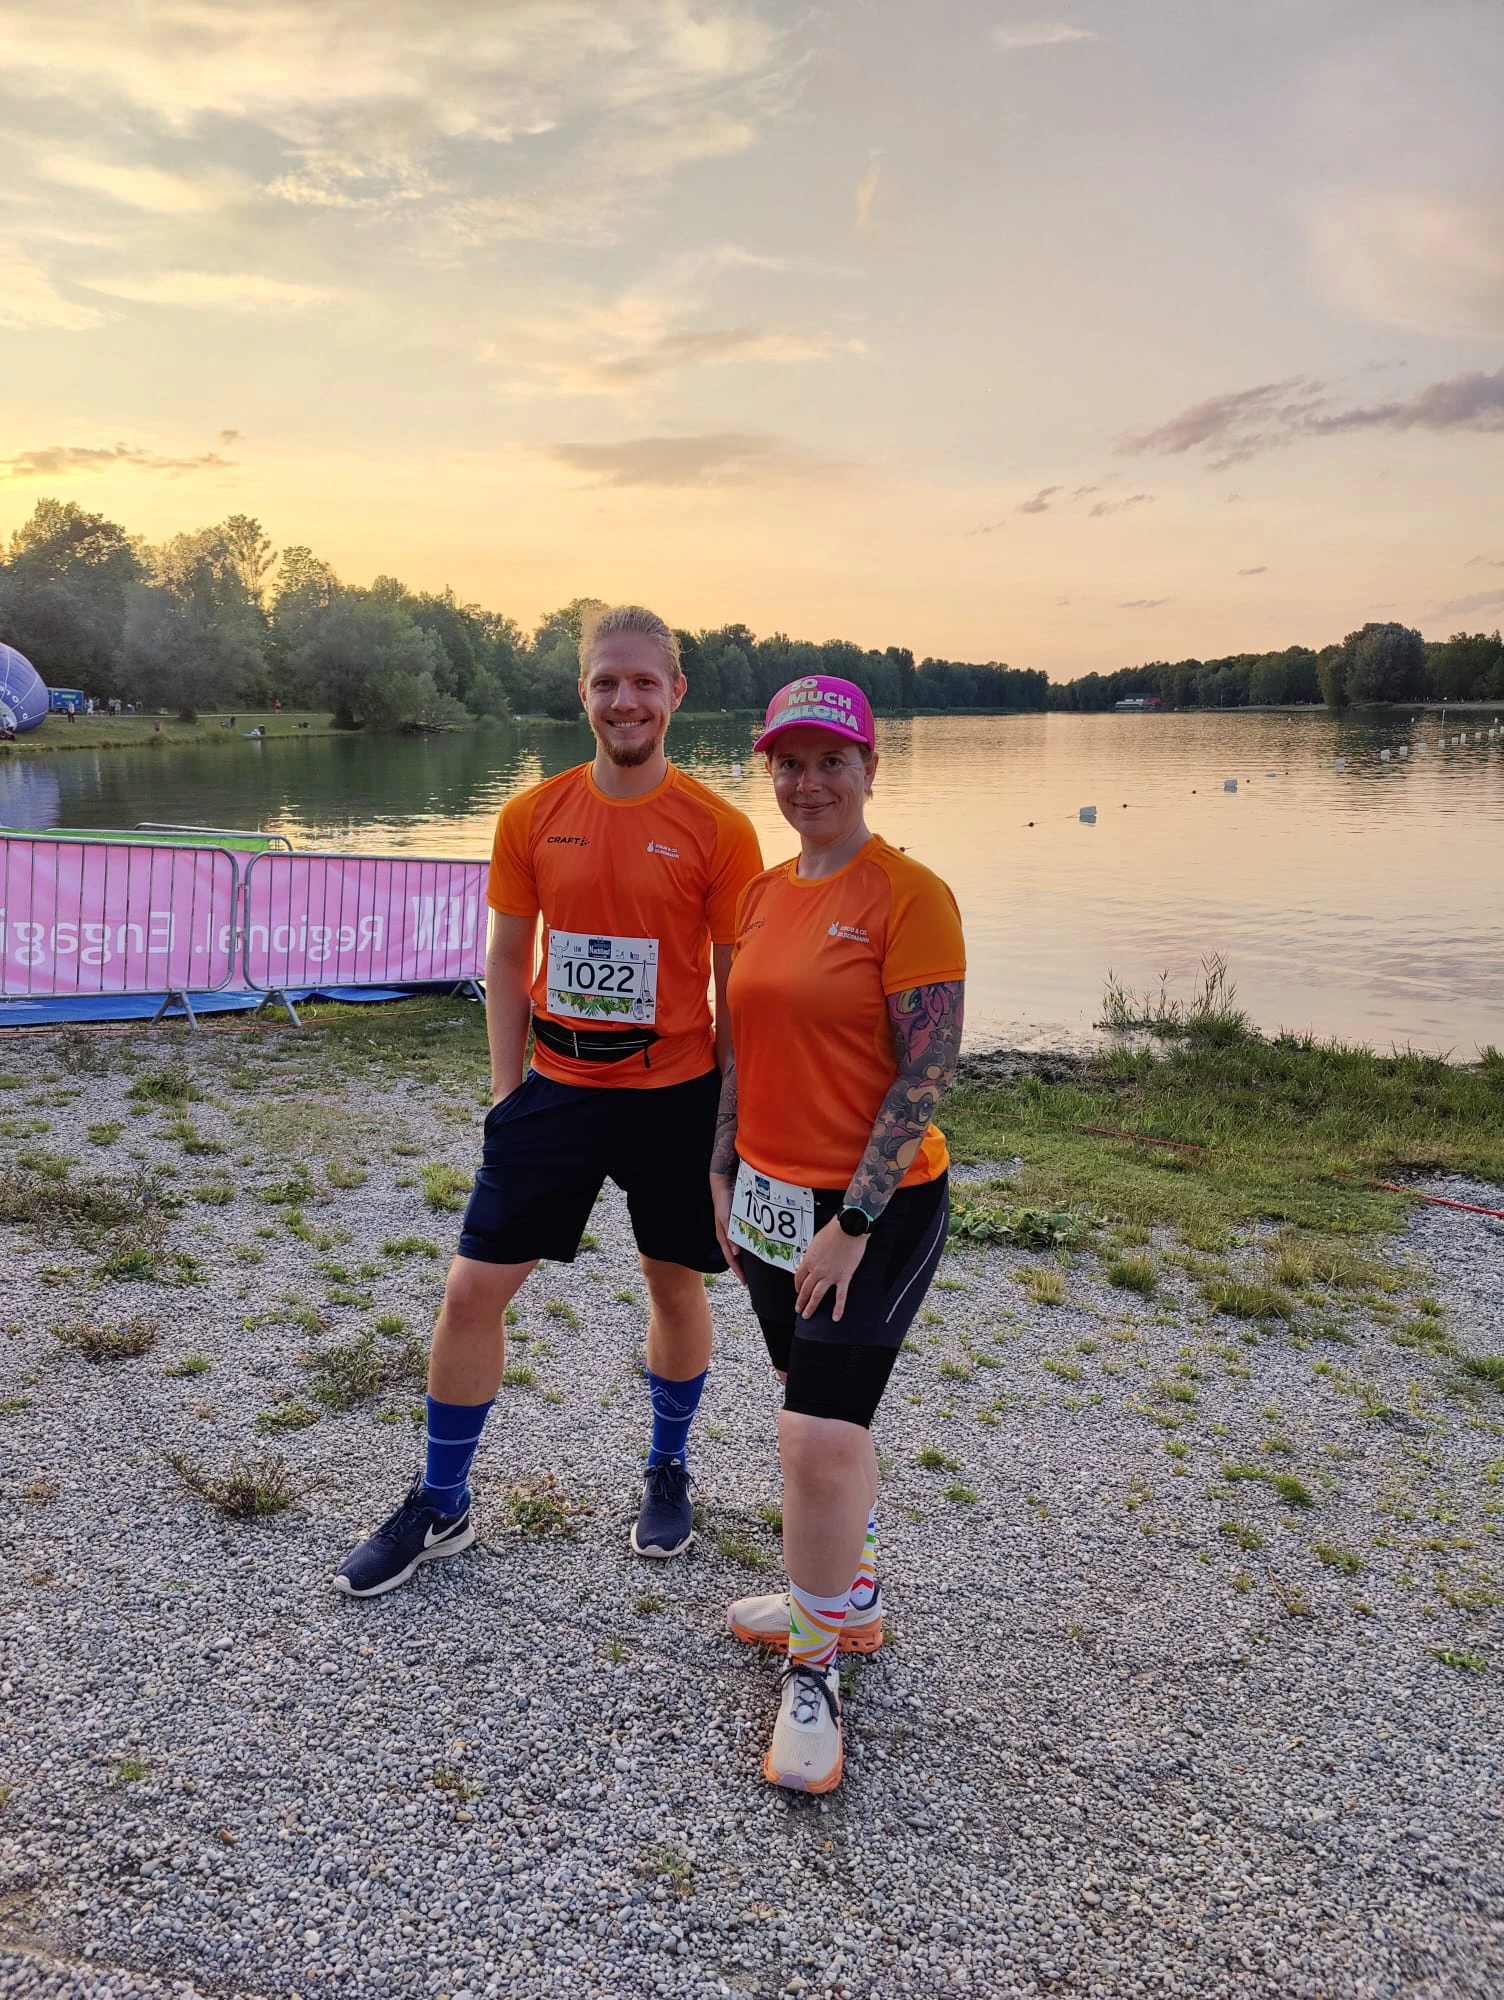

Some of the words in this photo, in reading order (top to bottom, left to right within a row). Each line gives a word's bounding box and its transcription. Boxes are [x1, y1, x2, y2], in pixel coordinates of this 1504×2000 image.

[791, 678, 818, 692] SO
[788, 690, 852, 710] MUCH
[547, 836, 580, 845] CRAFT
[563, 960, 635, 993] 1022
